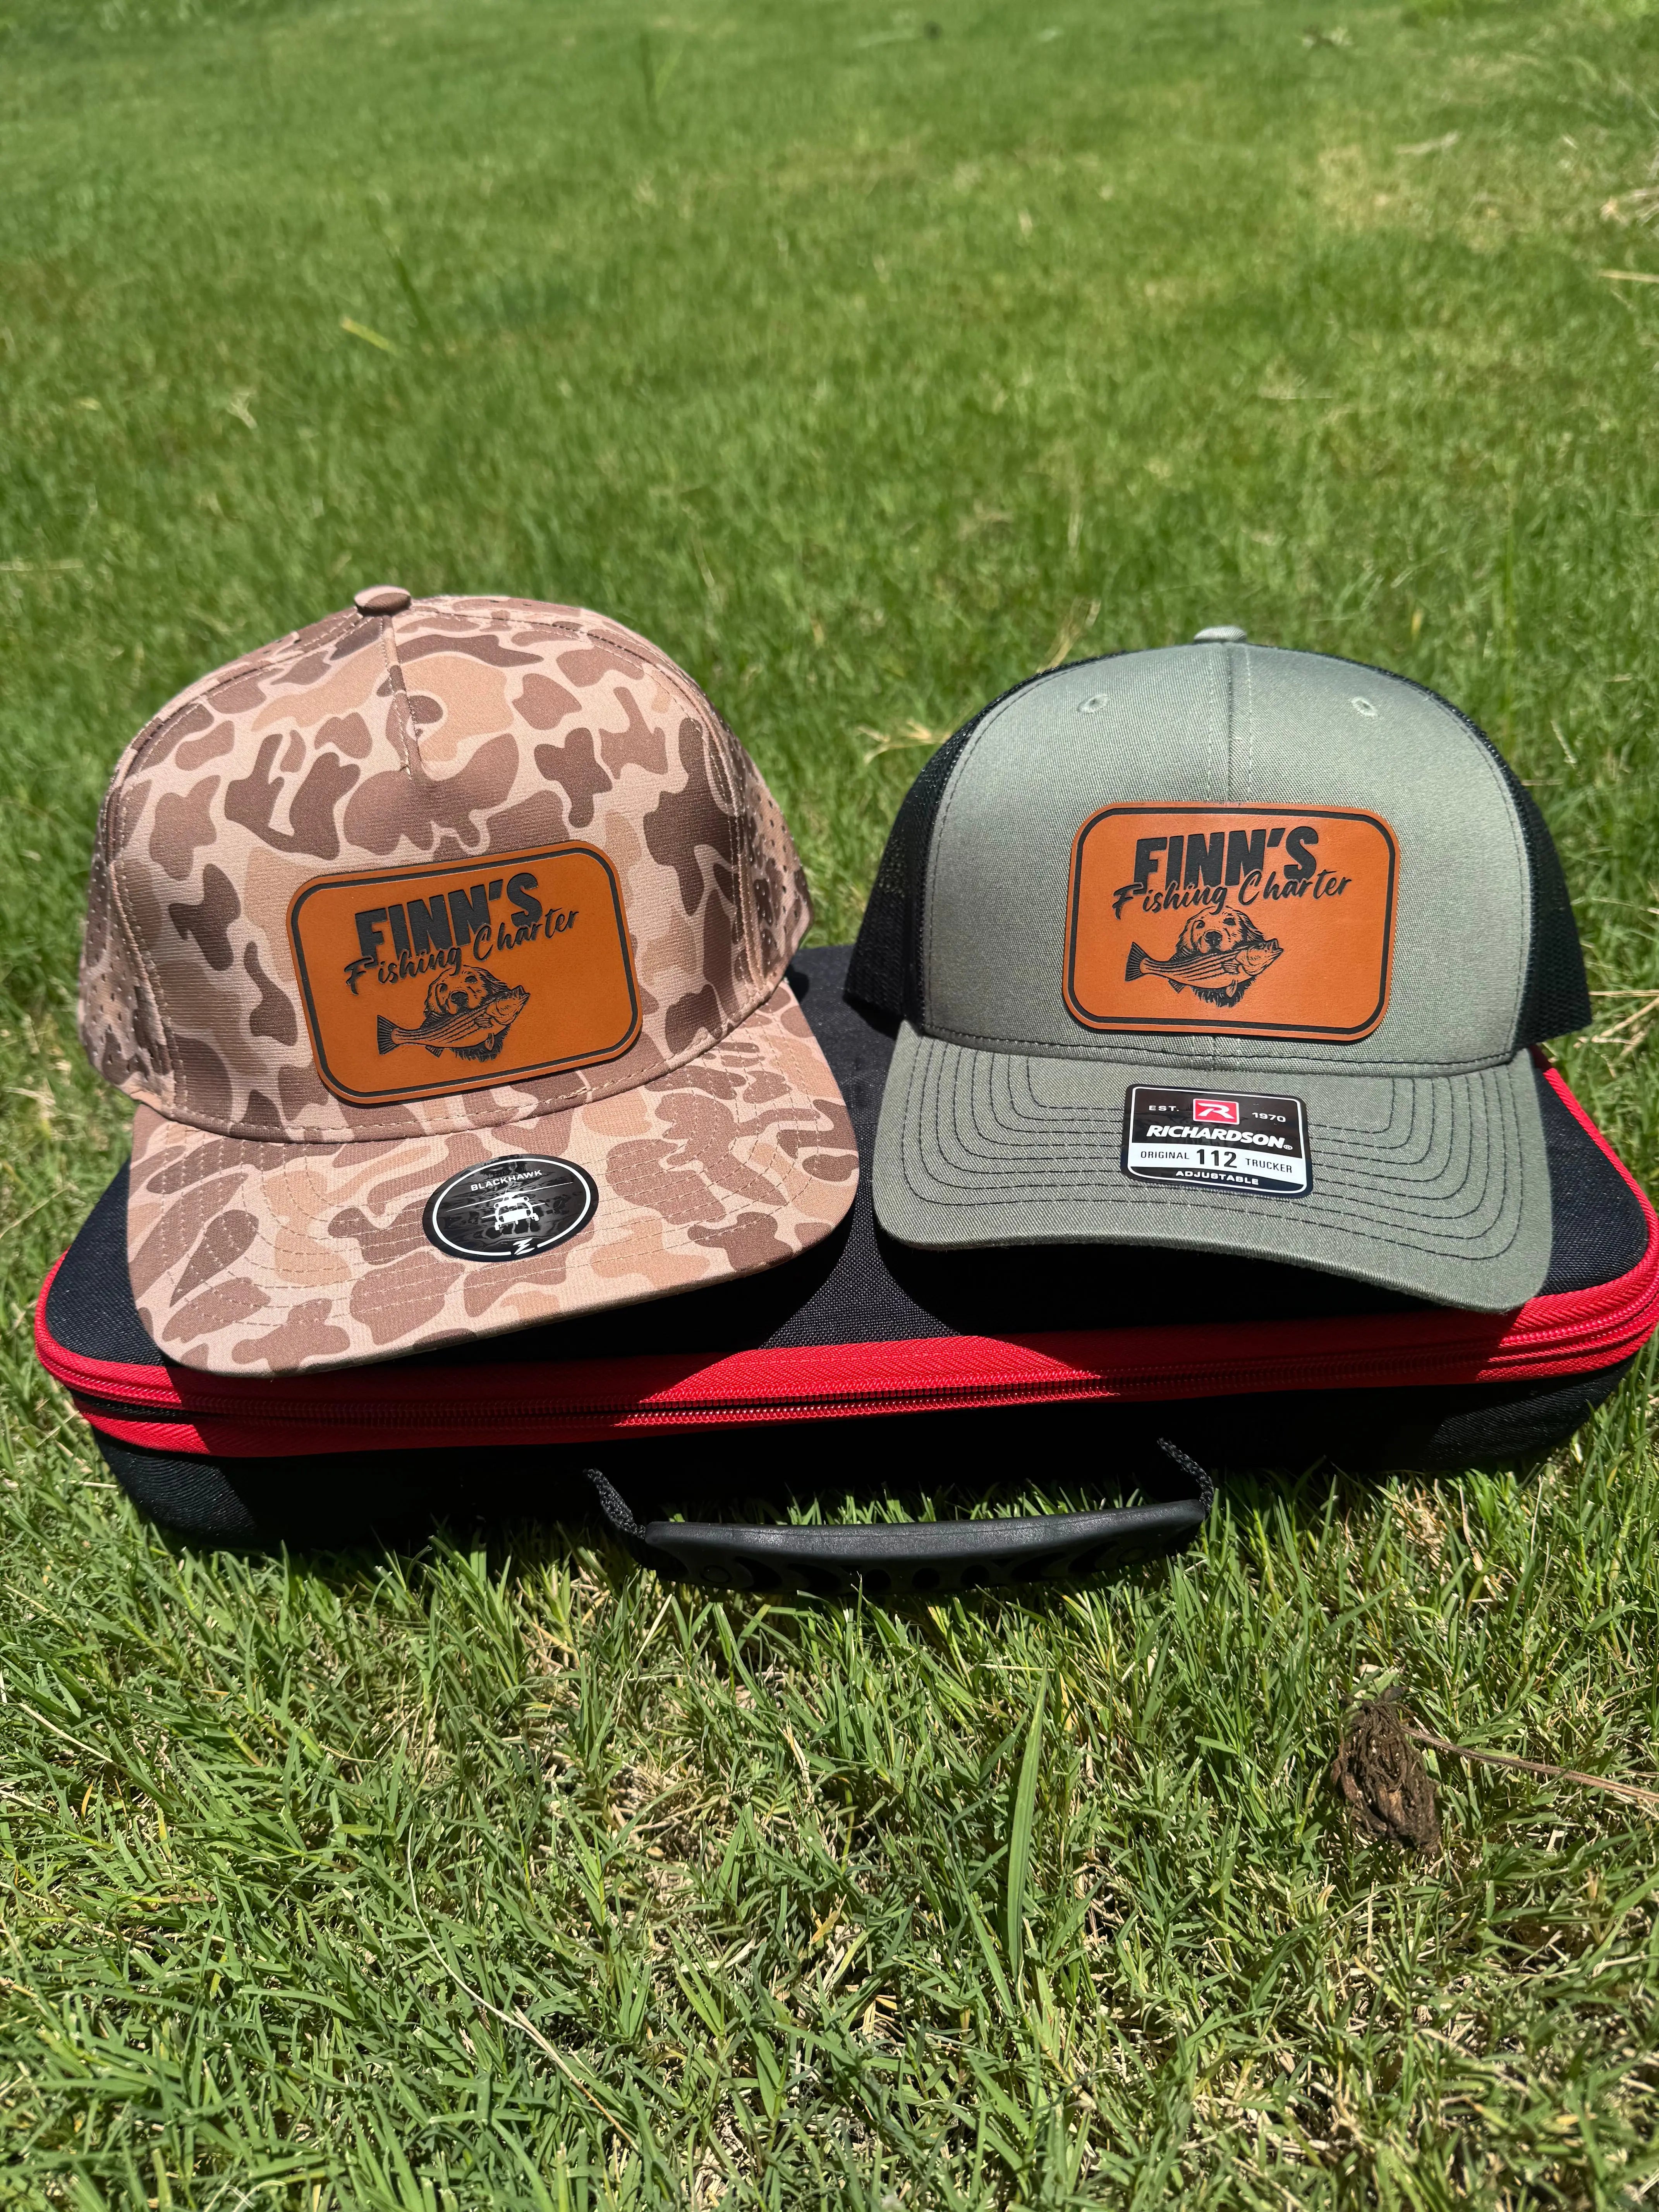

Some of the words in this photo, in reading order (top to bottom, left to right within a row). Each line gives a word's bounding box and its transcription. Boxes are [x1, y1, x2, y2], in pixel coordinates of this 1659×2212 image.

[1133, 826, 1319, 895] FINN'S
[1112, 880, 1228, 921] Fishing
[1238, 869, 1353, 907] Charter
[355, 872, 544, 967] FINN'S
[343, 946, 462, 996] Fishing
[473, 907, 580, 962] Charter
[1252, 1112, 1286, 1122] 1970
[1140, 1151, 1190, 1159] ORIGINAL
[1196, 1149, 1237, 1168] 112
[1245, 1158, 1292, 1173] TRUCKER
[1176, 1170, 1259, 1185] ADJUSTABLE
[471, 1169, 543, 1192] BLACKHAWK
